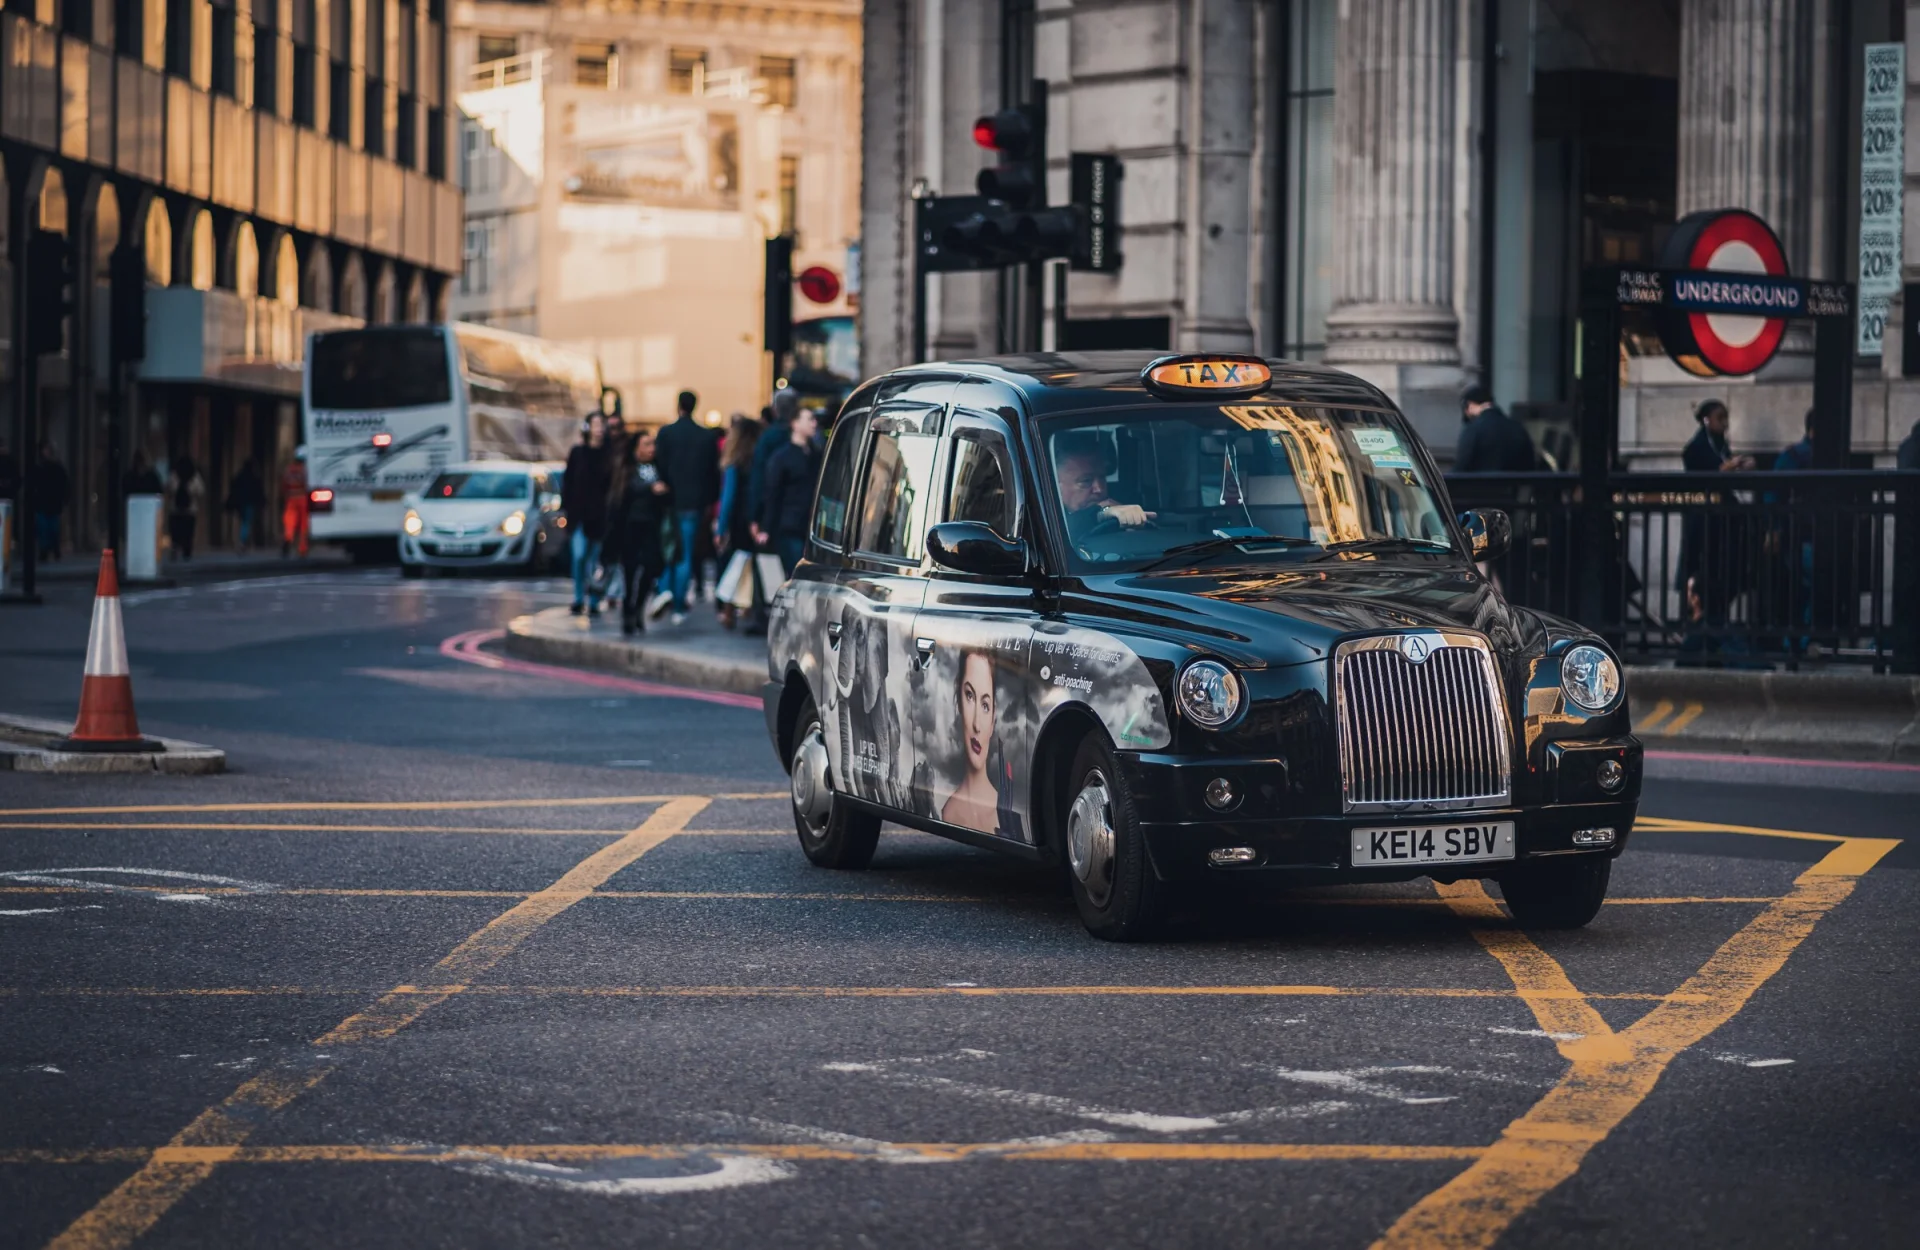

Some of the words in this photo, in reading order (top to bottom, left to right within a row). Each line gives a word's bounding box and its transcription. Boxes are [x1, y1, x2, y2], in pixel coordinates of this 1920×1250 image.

[1619, 270, 1661, 288] PUBLIC
[1616, 285, 1665, 304] SUBWAY
[1675, 279, 1800, 308] UNDERGROUND
[1809, 283, 1848, 301] PUBLIC
[1806, 298, 1850, 317] SUBWAY
[1044, 640, 1055, 656] Lip
[1069, 643, 1089, 660] Space
[1088, 646, 1099, 660] for
[1098, 649, 1121, 664] Giants
[1053, 673, 1094, 694] anti-poaching
[1370, 829, 1436, 860] KE14
[1445, 825, 1498, 856] SBV
